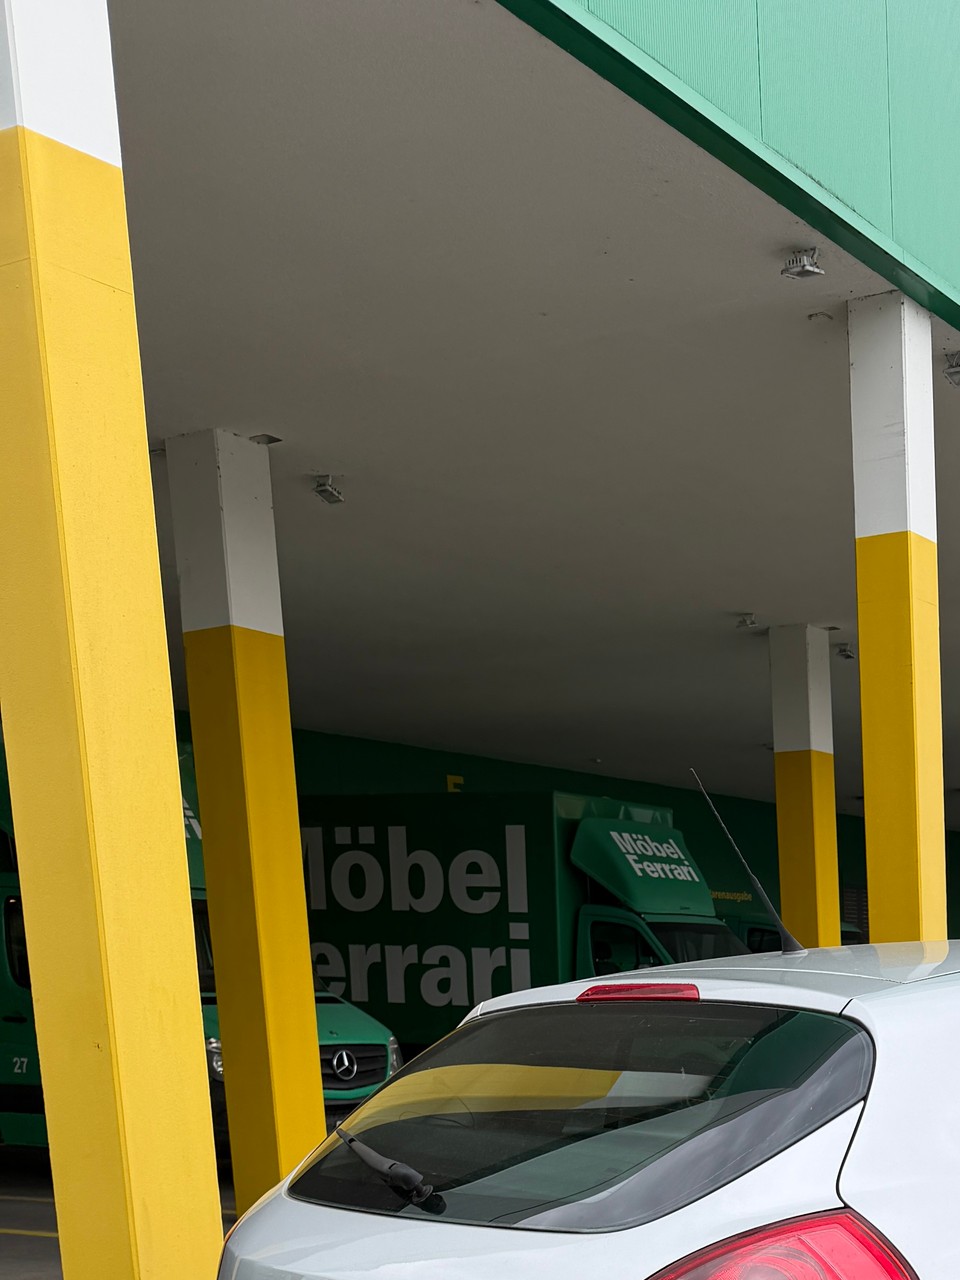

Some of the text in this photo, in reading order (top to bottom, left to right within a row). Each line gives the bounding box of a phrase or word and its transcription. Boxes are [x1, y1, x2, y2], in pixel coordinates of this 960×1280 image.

[609, 830, 687, 860] Möbel
[625, 853, 701, 883] Ferrari
[311, 922, 532, 1007] errari
[12, 1056, 28, 1074] 27
